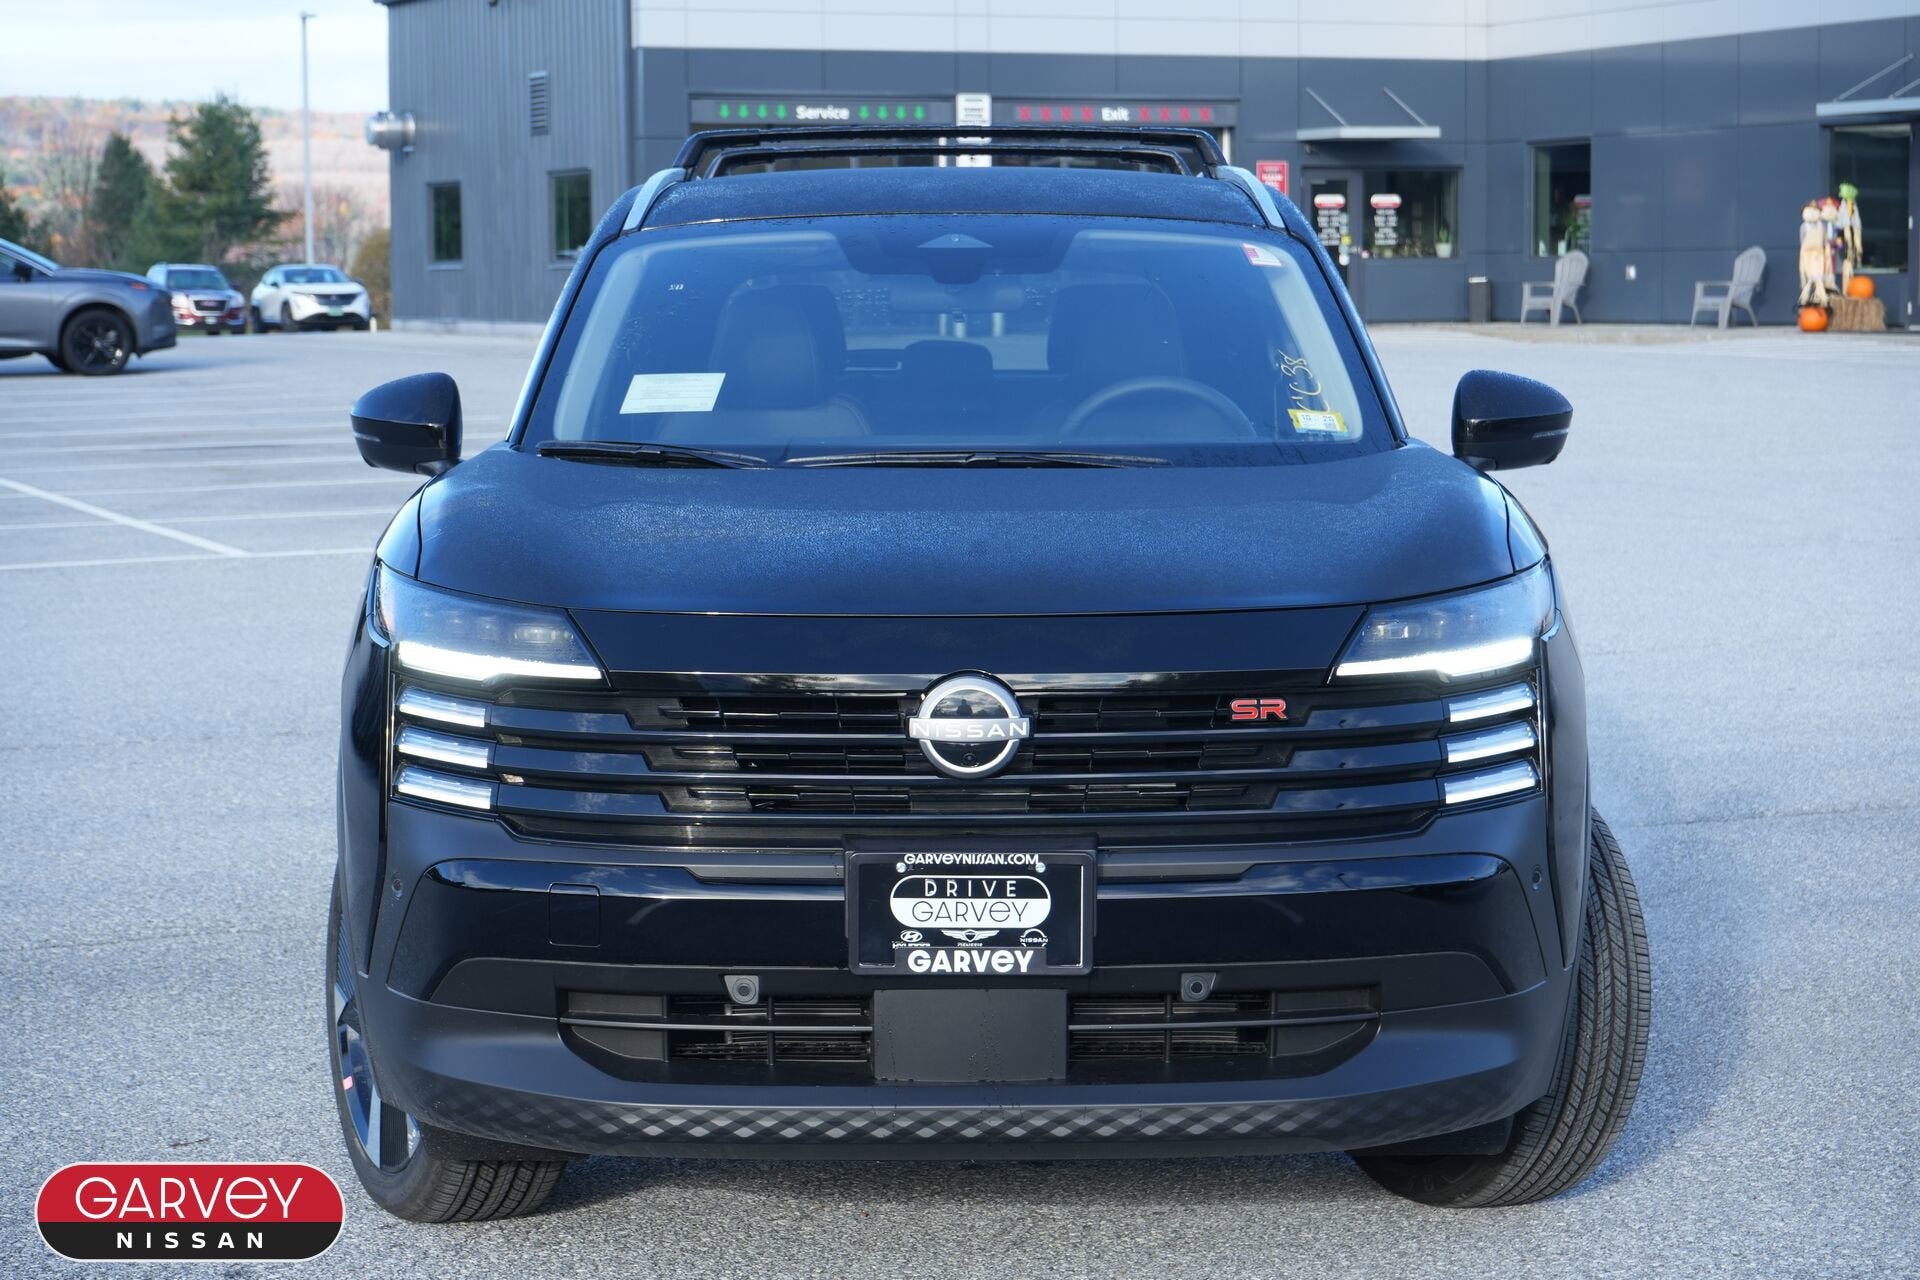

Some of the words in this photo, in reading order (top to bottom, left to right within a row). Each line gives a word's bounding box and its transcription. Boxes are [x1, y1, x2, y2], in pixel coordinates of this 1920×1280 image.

[796, 105, 850, 120] Service
[1102, 107, 1131, 121] Exit
[1230, 699, 1287, 720] SR
[910, 718, 1028, 738] NISSAN
[924, 879, 1017, 897] DRIVE
